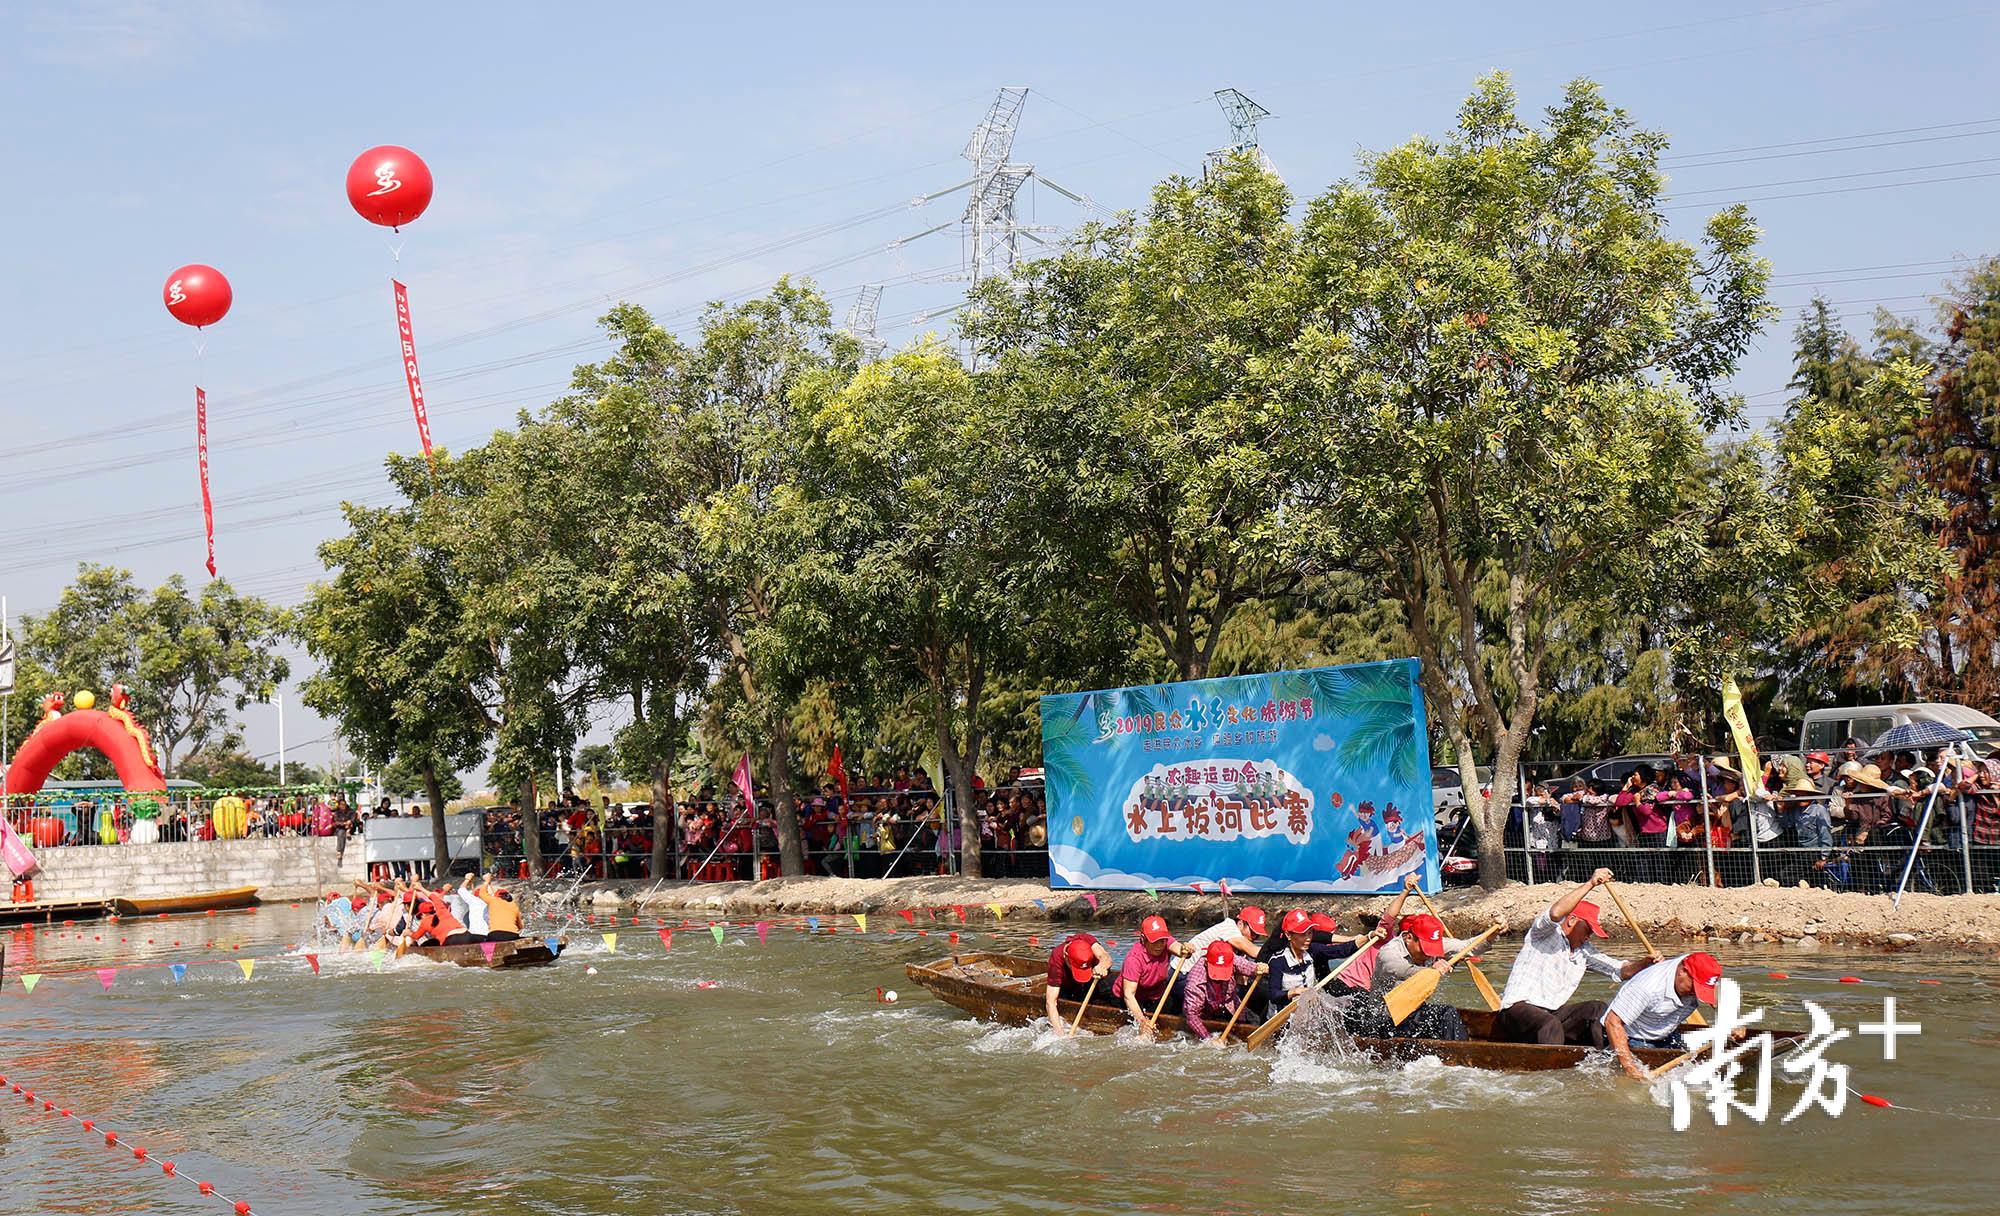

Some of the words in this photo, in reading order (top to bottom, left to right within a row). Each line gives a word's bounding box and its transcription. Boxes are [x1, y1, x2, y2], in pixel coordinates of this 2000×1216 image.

[1116, 696, 1314, 734] 2019民众水乡文化旅游节
[1167, 761, 1258, 785] 农趣运动会
[1127, 789, 1309, 836] 水上拔河比赛
